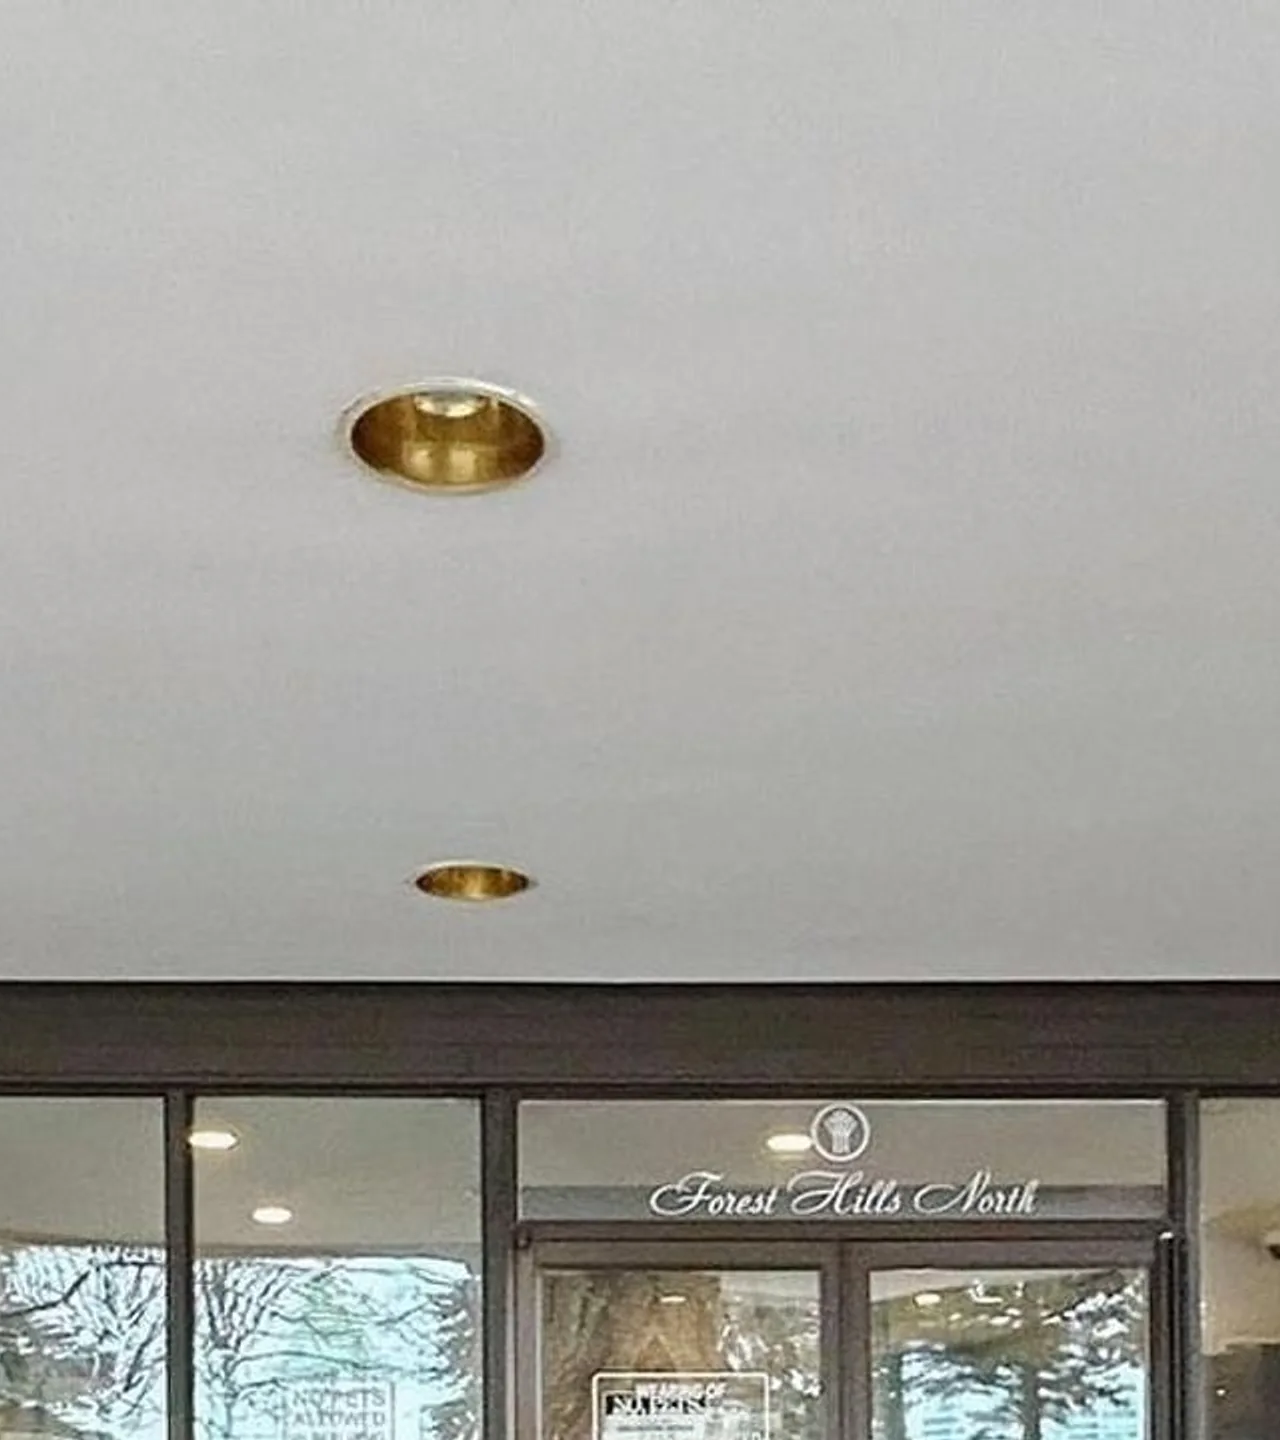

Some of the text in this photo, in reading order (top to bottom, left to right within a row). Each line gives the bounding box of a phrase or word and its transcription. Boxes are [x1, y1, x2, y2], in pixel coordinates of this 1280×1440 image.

[650, 1168, 1041, 1217] Forest Hills North
